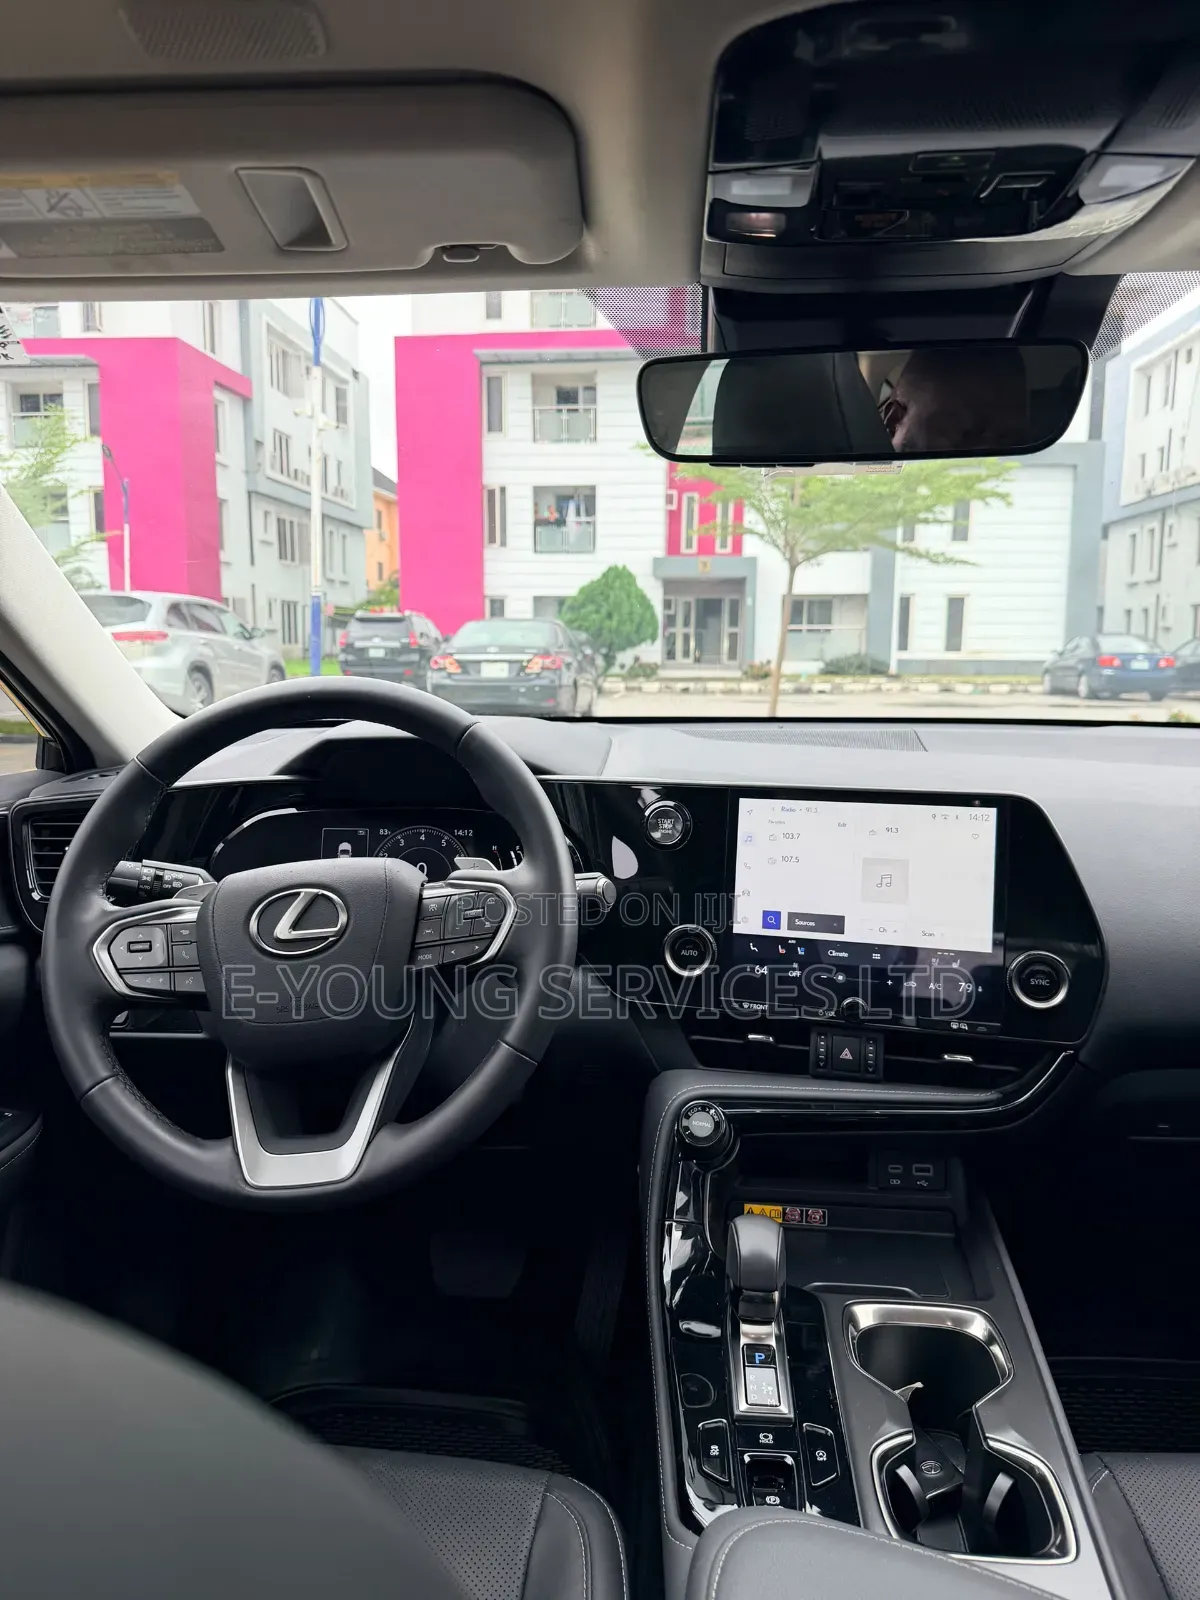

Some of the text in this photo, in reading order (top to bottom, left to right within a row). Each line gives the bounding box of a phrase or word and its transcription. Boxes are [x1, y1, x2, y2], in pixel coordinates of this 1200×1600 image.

[781, 805, 796, 813] Radio
[969, 813, 990, 822] 14:12
[420, 833, 425, 841] 4
[454, 829, 473, 837] 14:12
[782, 832, 801, 840] 103.7
[399, 838, 405, 846] 3
[441, 839, 447, 847] 5
[781, 855, 800, 863] 107.5
[795, 918, 816, 927] Sources
[680, 949, 699, 957] AUTO
[827, 949, 849, 958] Climate
[754, 964, 768, 975] 64
[788, 969, 802, 977] OFF
[928, 982, 942, 990] A/C
[1030, 978, 1050, 986] SYNC
[958, 982, 973, 993] 79
[749, 1003, 769, 1011] FRONT
[688, 1107, 698, 1116] ECO
[692, 1120, 712, 1128] NORMAL
[754, 1352, 766, 1364] P
